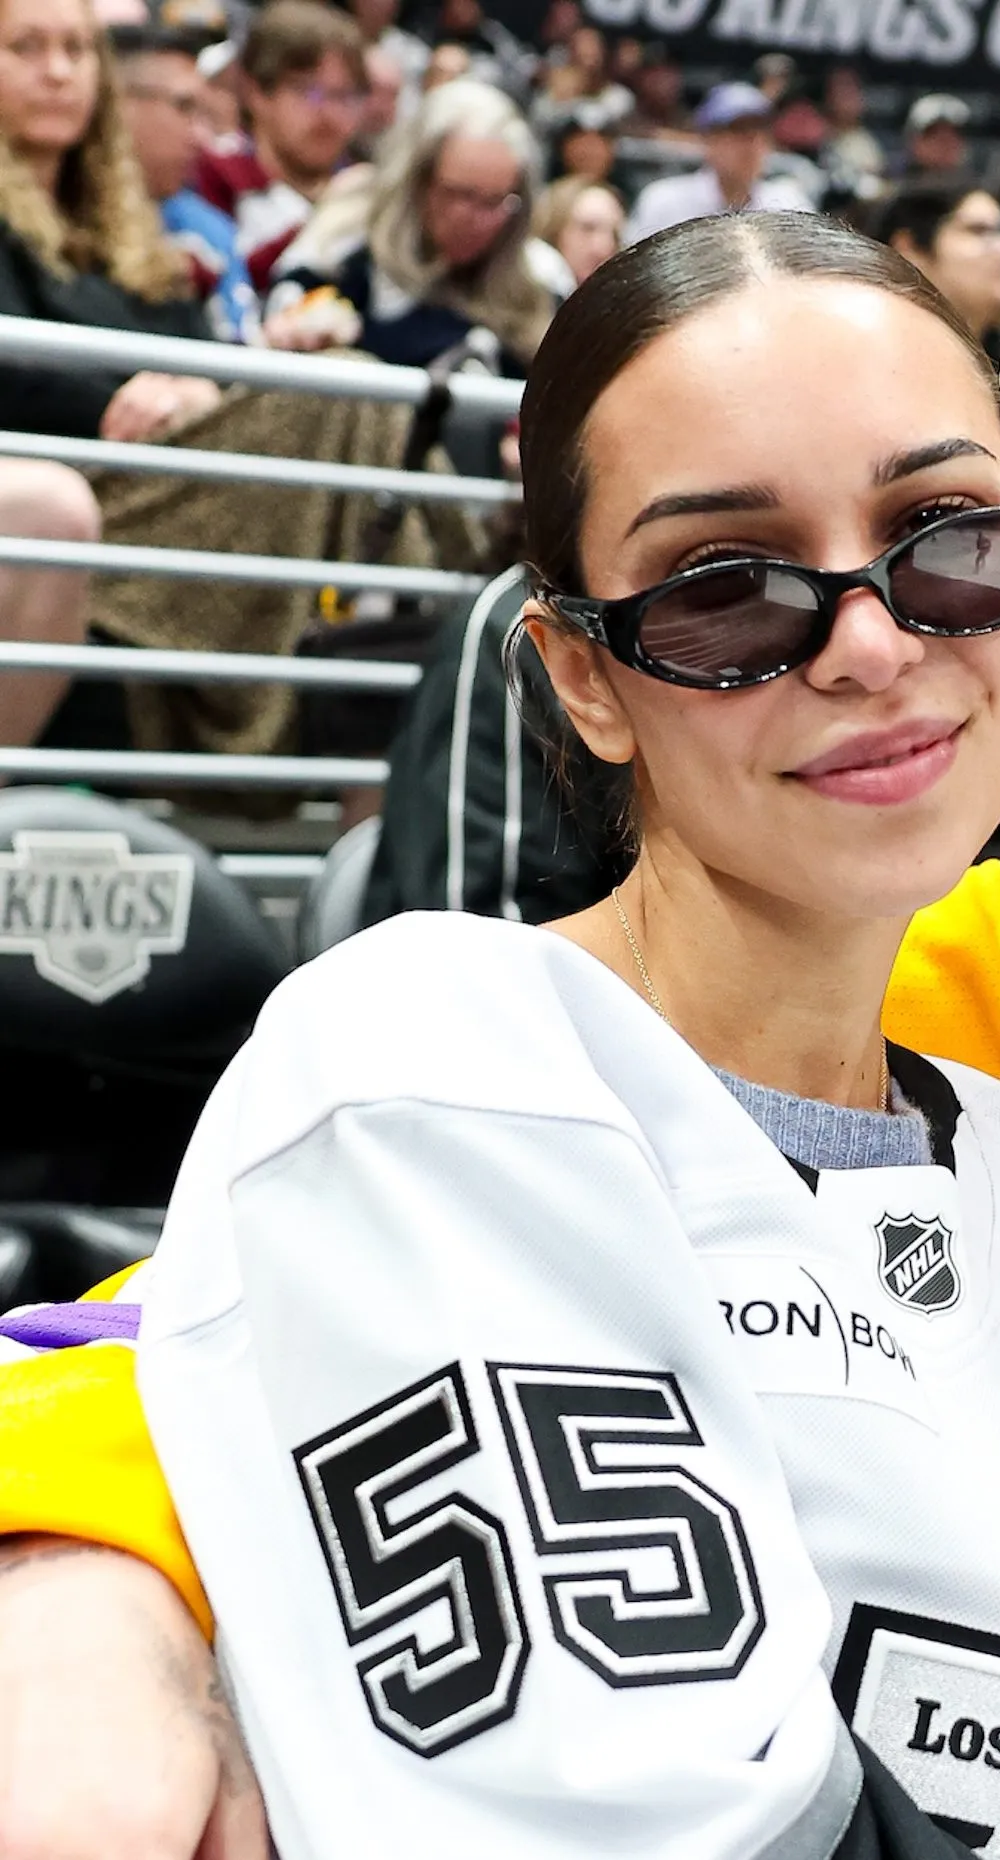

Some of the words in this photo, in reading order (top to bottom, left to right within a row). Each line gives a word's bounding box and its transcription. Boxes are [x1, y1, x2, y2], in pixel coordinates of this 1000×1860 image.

[3, 872, 173, 932] KINGS
[893, 1237, 944, 1295] NHL
[292, 1360, 766, 1759] 55
